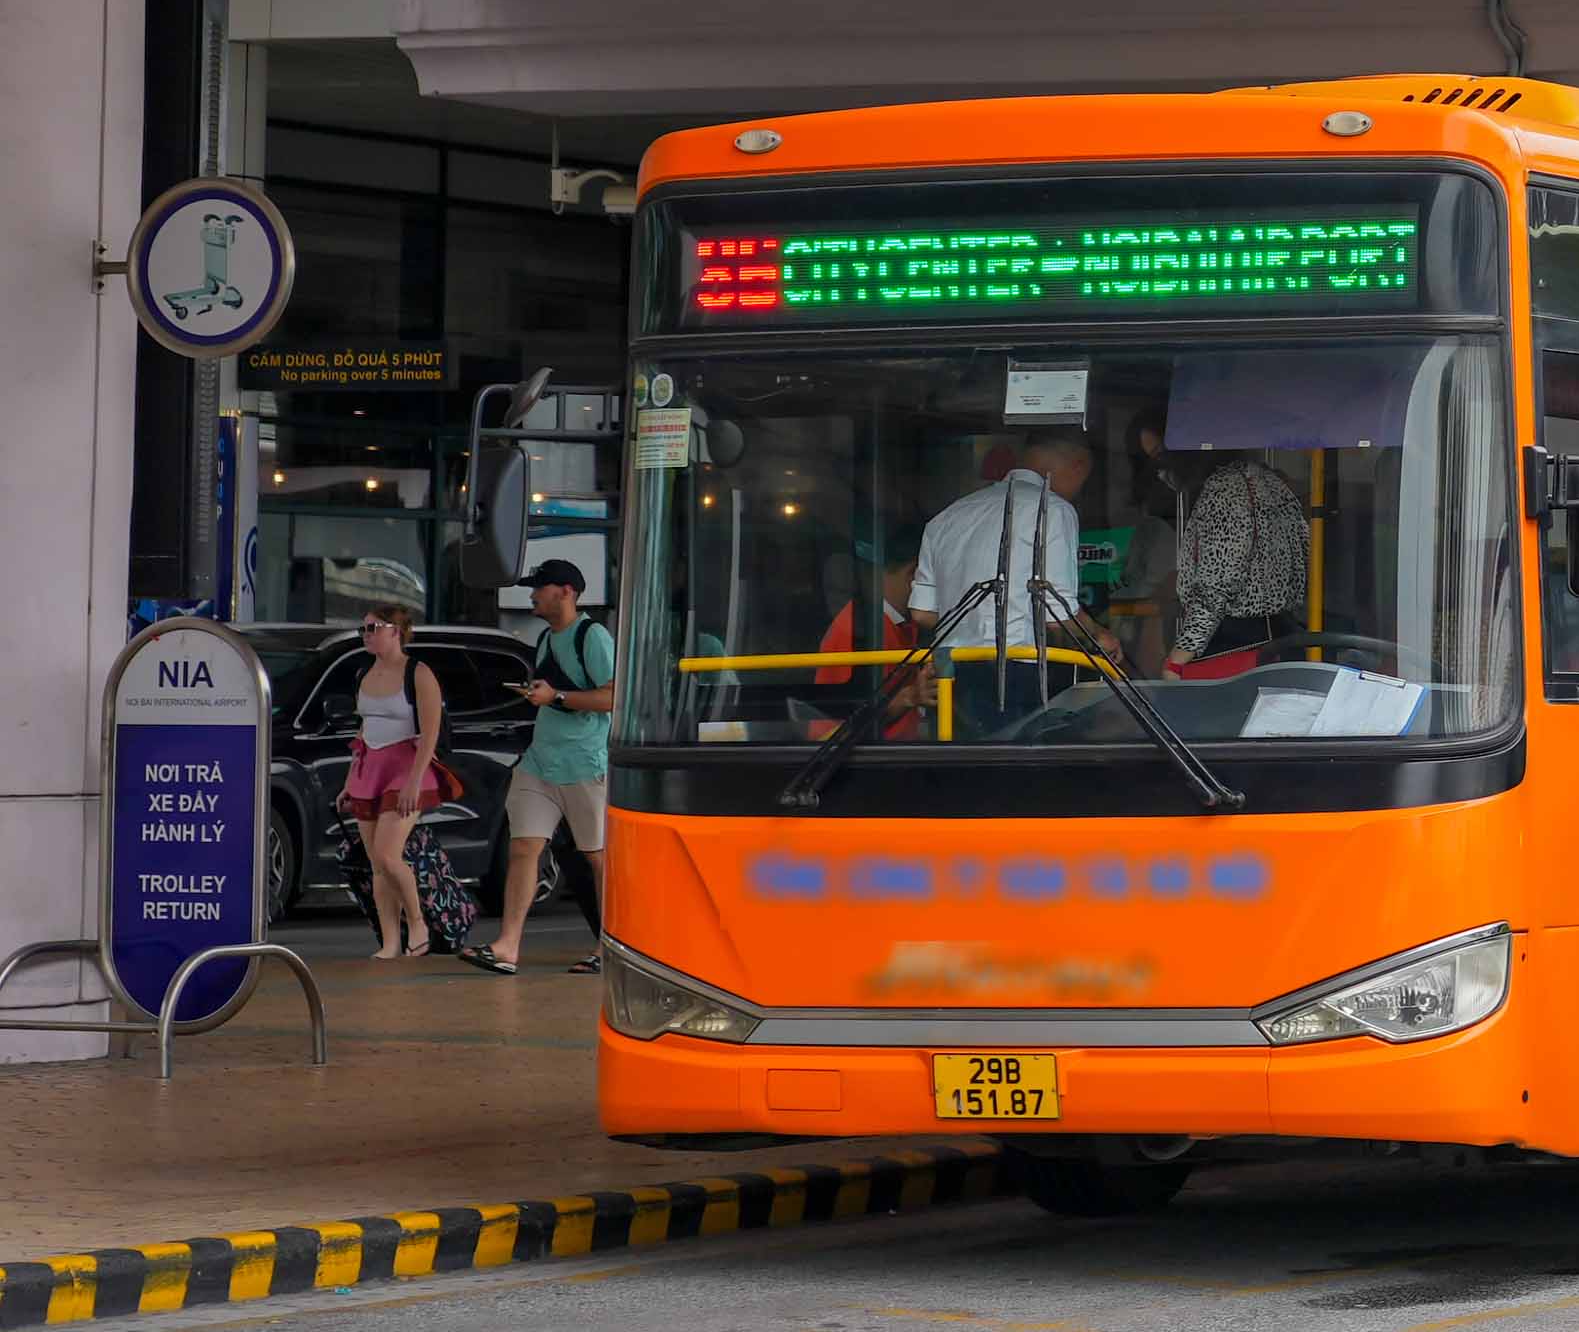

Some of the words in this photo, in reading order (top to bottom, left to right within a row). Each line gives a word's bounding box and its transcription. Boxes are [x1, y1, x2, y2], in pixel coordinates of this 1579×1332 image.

[392, 353, 400, 366] 5
[281, 370, 297, 381] No
[301, 370, 348, 383] parking
[352, 372, 377, 381] over
[381, 370, 388, 381] 5
[392, 369, 442, 381] minutes
[158, 660, 215, 688] NIA
[213, 698, 249, 707] AIRPORT
[144, 763, 180, 783] NƠI
[184, 759, 224, 784] TRẢ
[148, 793, 174, 813] XE
[141, 818, 196, 843] HÀNH
[200, 819, 225, 843] LÝ
[138, 874, 227, 894] TROLLEY
[143, 900, 221, 921] RETURN
[968, 1057, 1021, 1085] 29B
[951, 1088, 1044, 1117] 151.87
